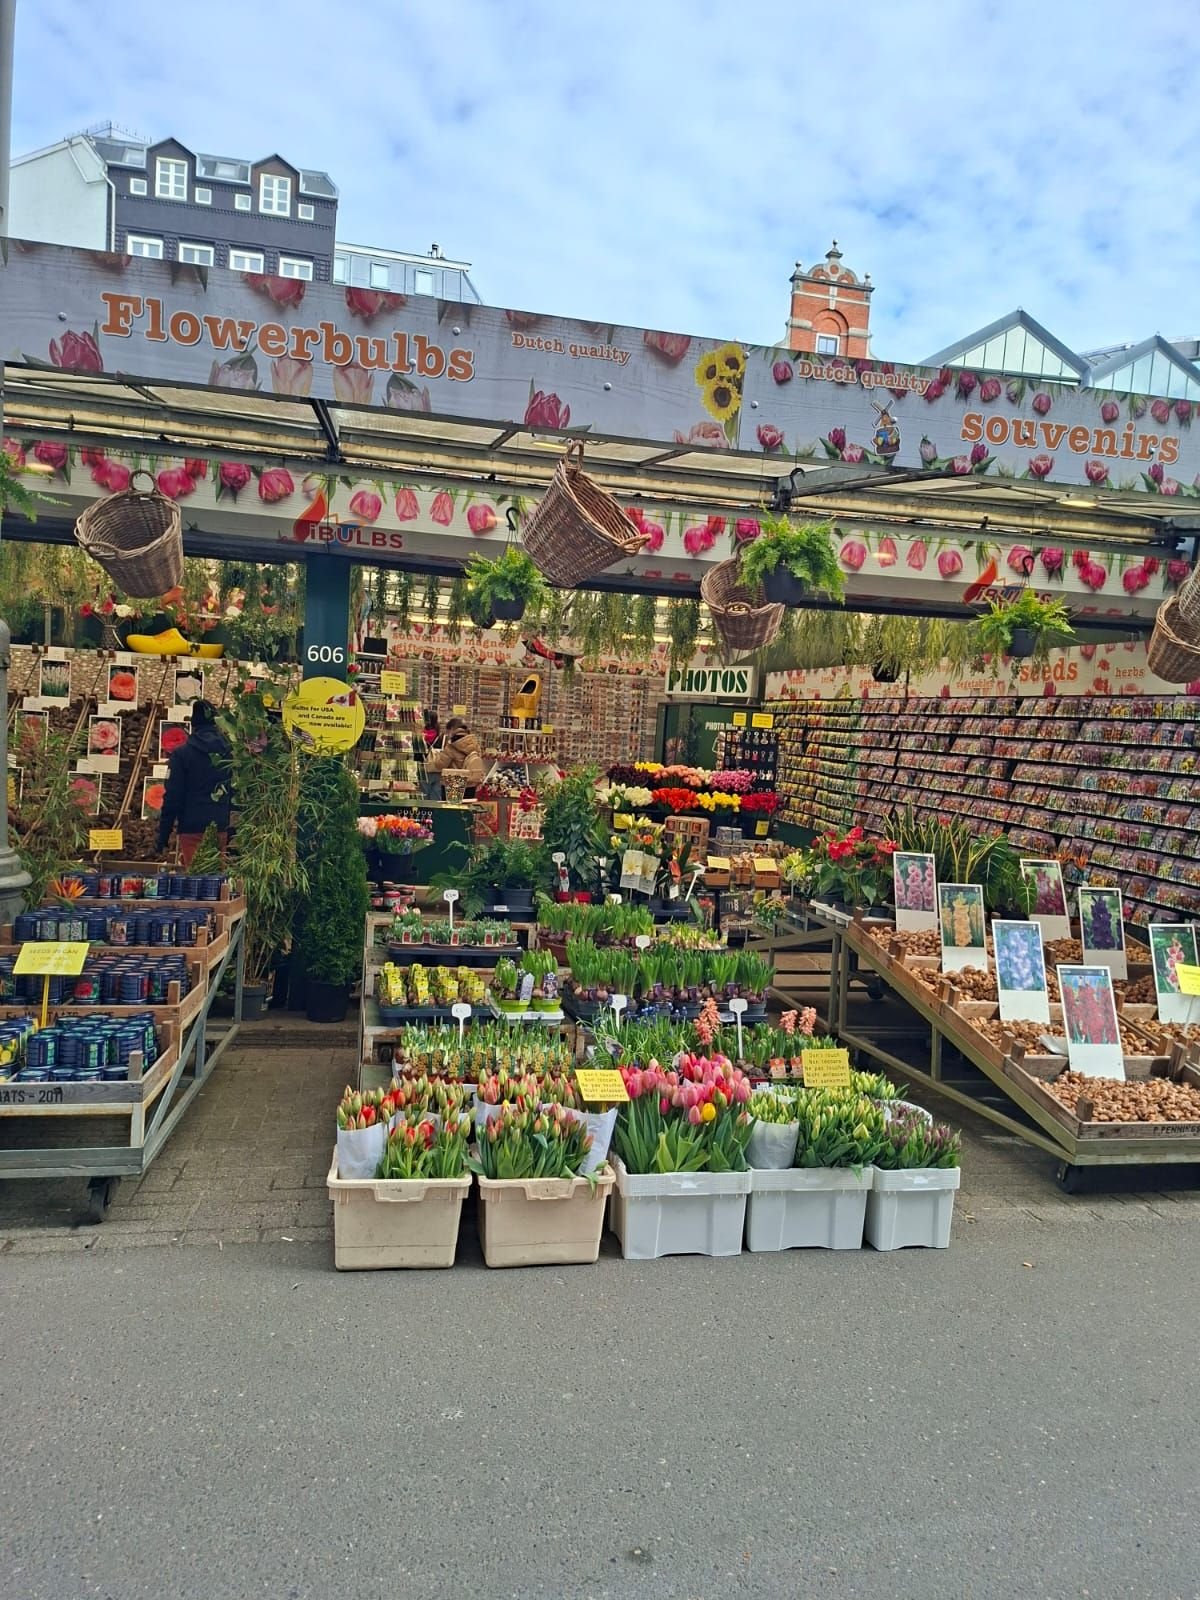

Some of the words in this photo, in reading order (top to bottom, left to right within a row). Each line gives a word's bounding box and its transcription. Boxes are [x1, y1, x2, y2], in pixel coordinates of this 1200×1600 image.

[101, 291, 475, 382] Flowerbulbs
[512, 332, 564, 353] Dutch
[569, 343, 631, 366] quality
[799, 361, 857, 383] Dutch
[861, 371, 931, 396] quality
[961, 412, 1180, 464] souvenirs
[309, 523, 403, 549] iBULBS
[307, 644, 344, 664] 606
[464, 637, 516, 649] magnes
[668, 669, 748, 694] PHOTOS
[1019, 657, 1078, 683] seeds
[1115, 666, 1145, 679] herbs
